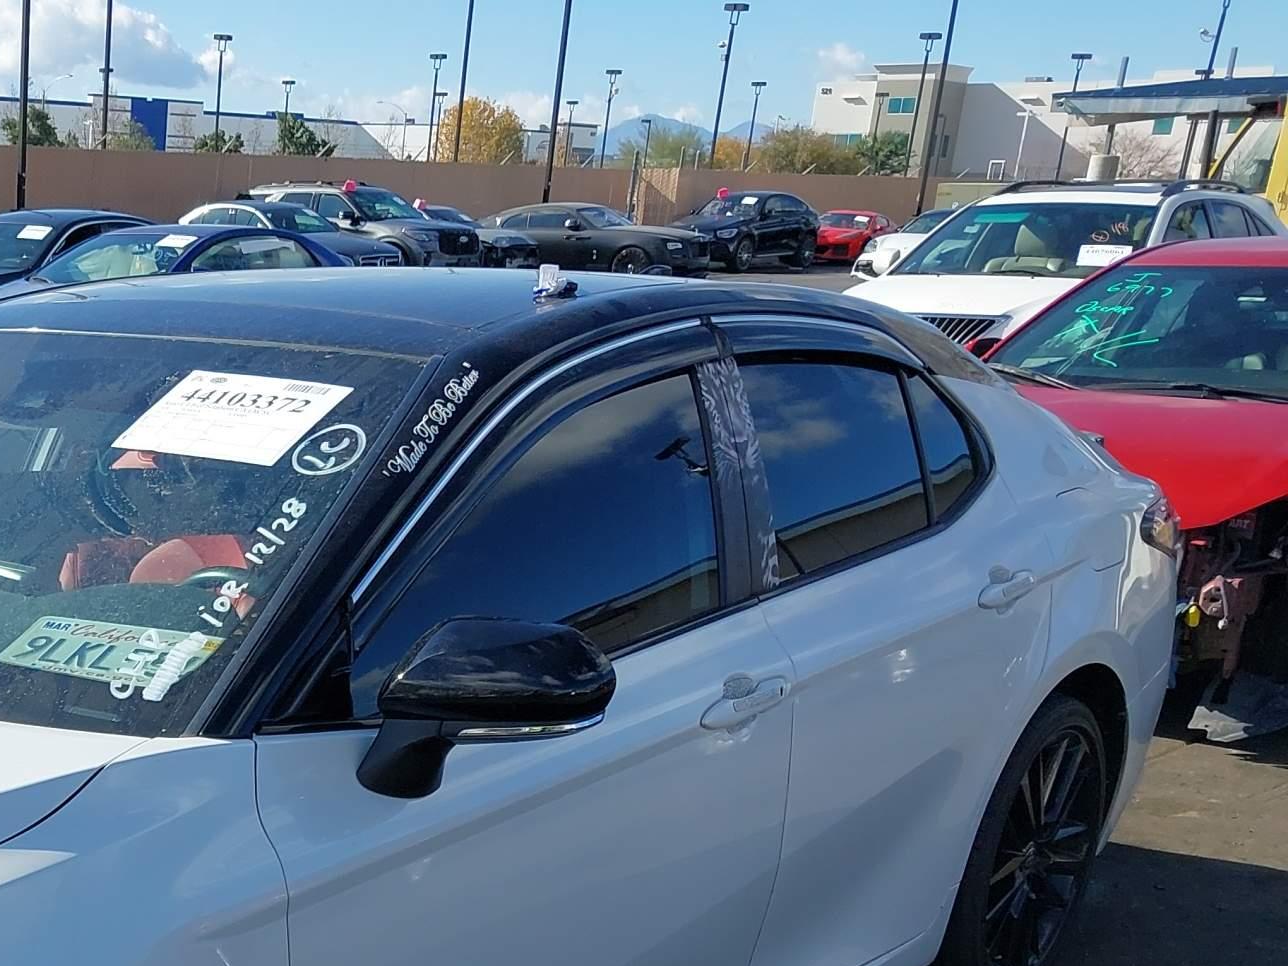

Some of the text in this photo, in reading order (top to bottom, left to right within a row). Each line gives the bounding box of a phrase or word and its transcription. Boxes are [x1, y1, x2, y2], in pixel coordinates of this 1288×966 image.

[180, 388, 313, 414] 44103372
[413, 414, 439, 443] To
[428, 399, 456, 426] Be
[244, 497, 308, 565] 12/28
[43, 621, 71, 631] MAR
